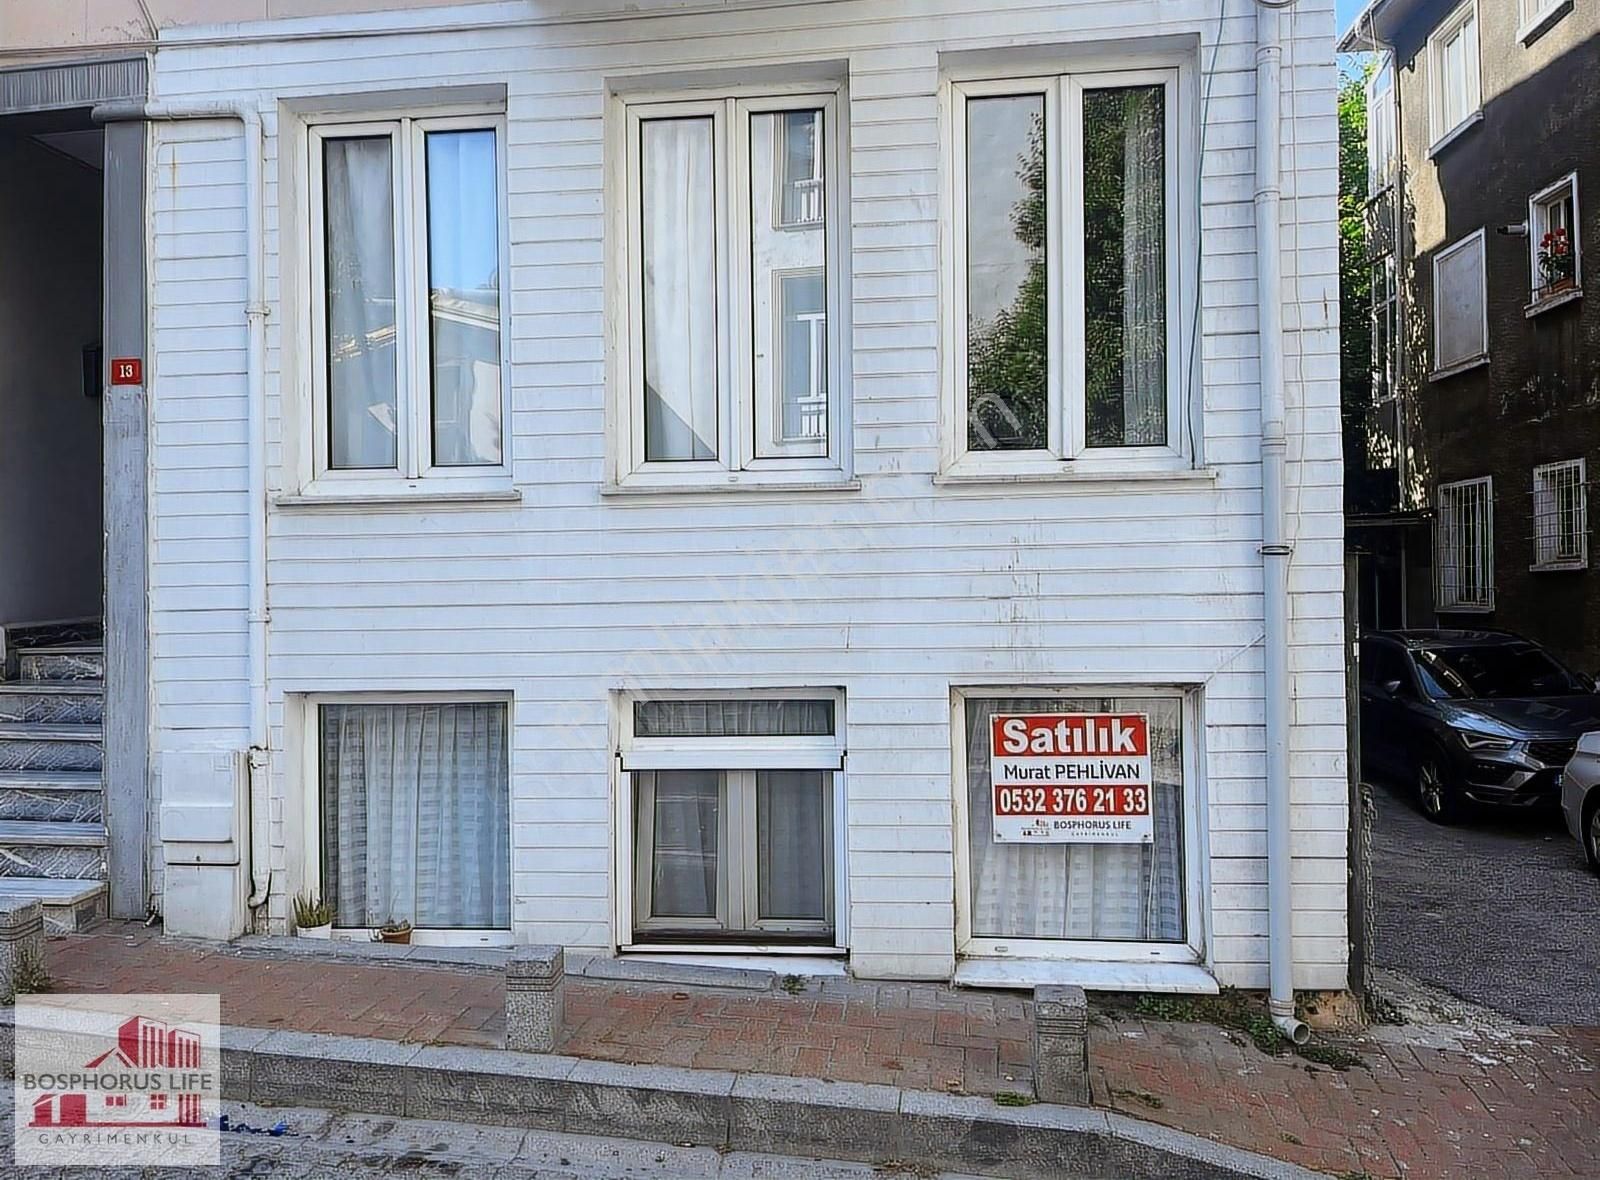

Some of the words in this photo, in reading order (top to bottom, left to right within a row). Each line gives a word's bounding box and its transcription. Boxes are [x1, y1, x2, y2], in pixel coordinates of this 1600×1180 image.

[120, 364, 133, 378] 13
[1003, 718, 1137, 753] Satılık
[1004, 764, 1051, 780] Murat
[1055, 760, 1140, 779] PEHLİVAN
[1000, 788, 1046, 813] 0532
[1052, 788, 1087, 813] 376
[1093, 788, 1116, 813] 21
[1123, 788, 1146, 813] 33
[1053, 820, 1111, 830] BOSPHORUS
[1112, 821, 1132, 829] LIFE
